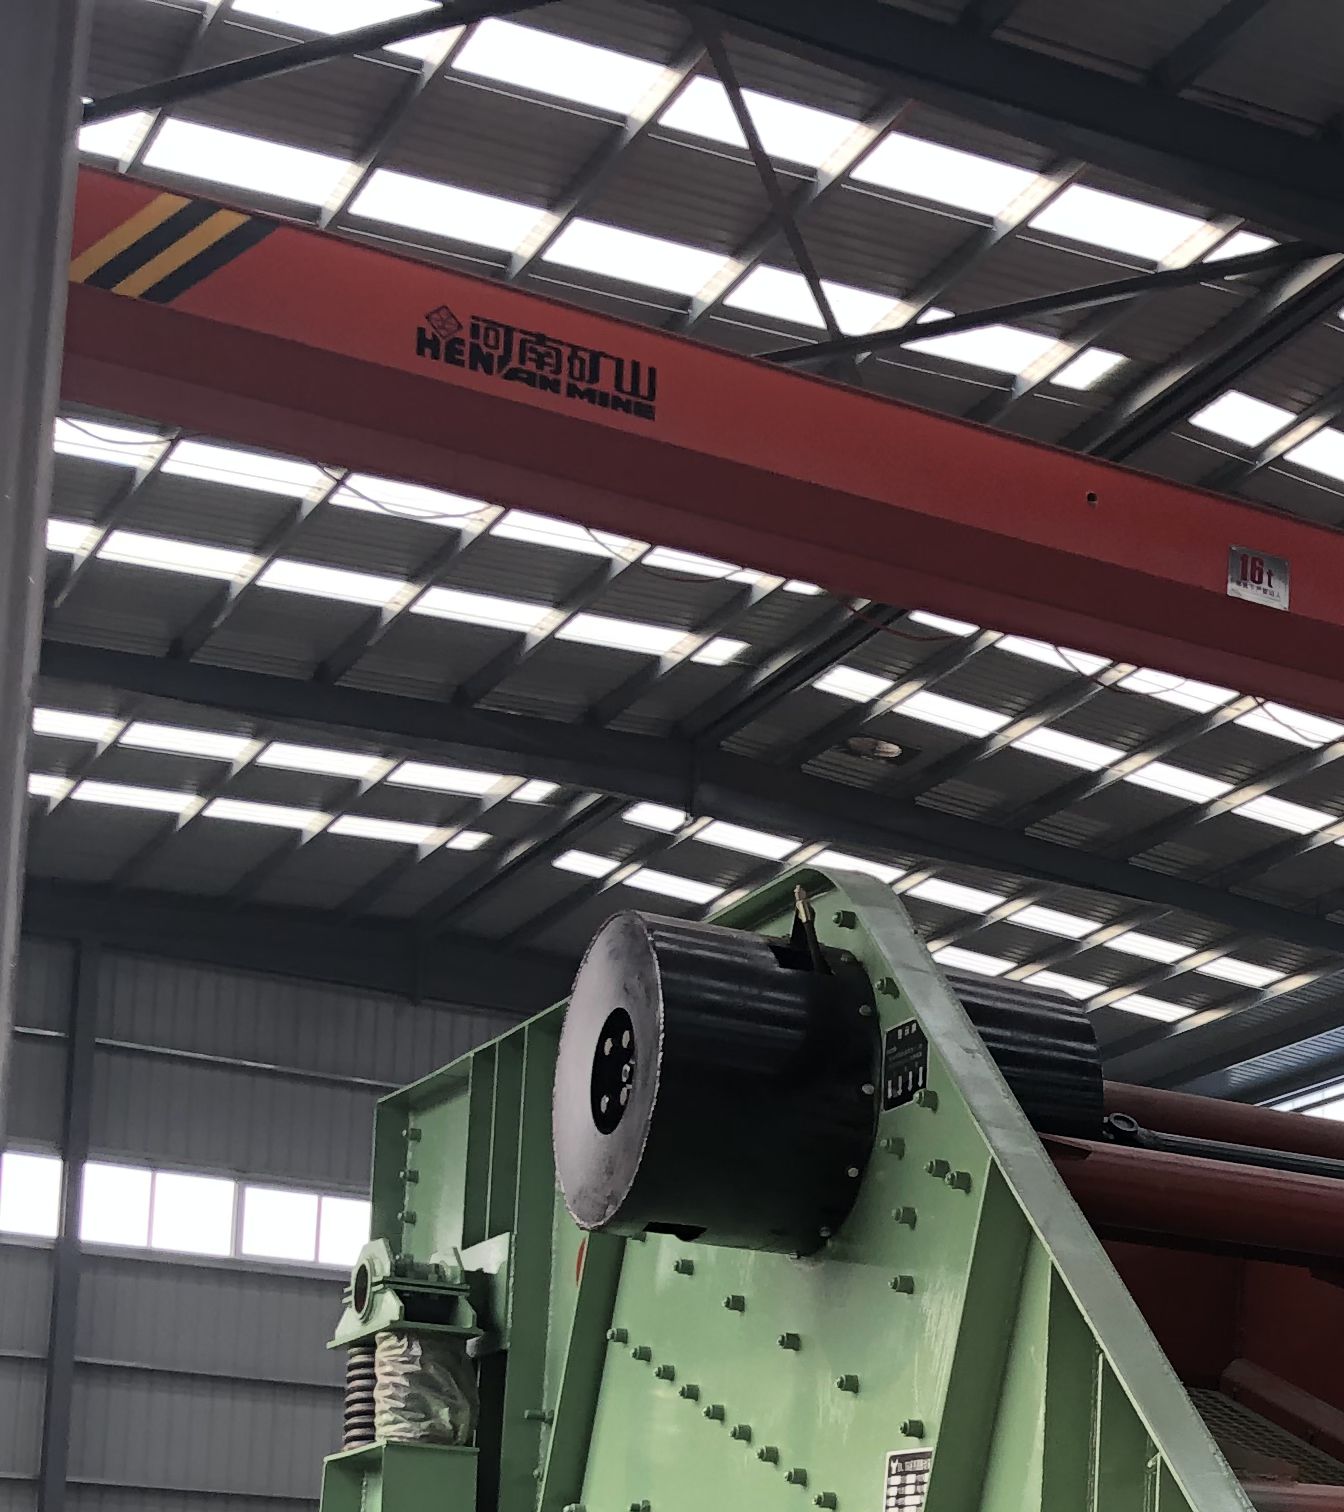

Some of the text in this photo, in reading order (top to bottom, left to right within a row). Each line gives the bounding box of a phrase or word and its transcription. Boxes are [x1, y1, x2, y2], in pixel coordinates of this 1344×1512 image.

[469, 315, 657, 402] 河南矿山
[567, 383, 656, 421] MINE
